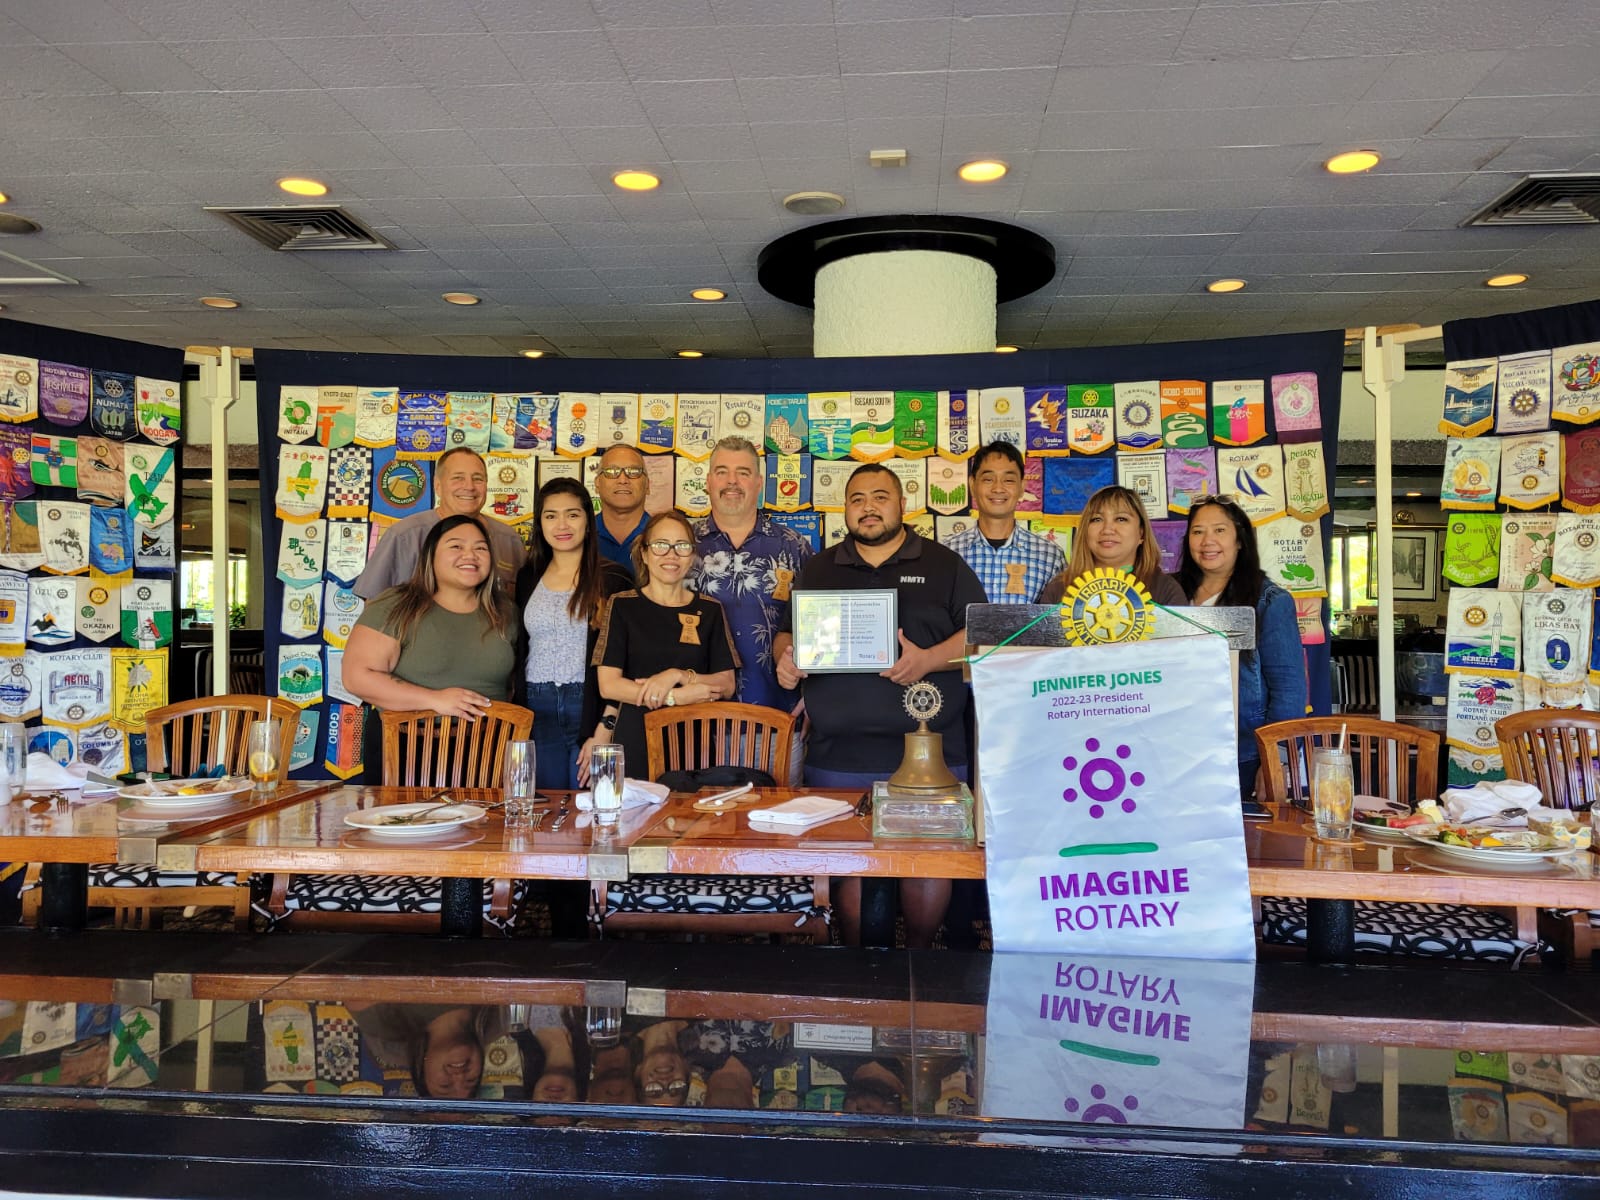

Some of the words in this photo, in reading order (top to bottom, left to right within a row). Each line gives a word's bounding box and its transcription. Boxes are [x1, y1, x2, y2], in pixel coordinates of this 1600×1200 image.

[96, 398, 128, 410] NUMATA
[1072, 408, 1108, 418] SUZAKA
[1230, 454, 1260, 462] ROTARY
[1290, 448, 1318, 460] ROTARY
[1558, 524, 1586, 536] ROTARY
[1082, 579, 1126, 598] ROTARY
[1074, 612, 1145, 646] INTEONAL
[1462, 656, 1499, 664] BERKELEY
[64, 674, 90, 686] RENO
[1032, 674, 1106, 698] JENNIFER
[1109, 670, 1162, 690] JONES
[1052, 694, 1092, 707] 2022-23
[1094, 692, 1144, 704] President
[1048, 708, 1080, 720] Rotary
[1083, 704, 1150, 716] International
[328, 712, 340, 744] GOBO
[1039, 868, 1190, 900] IMAGINE
[1055, 902, 1180, 932] ROTARY
